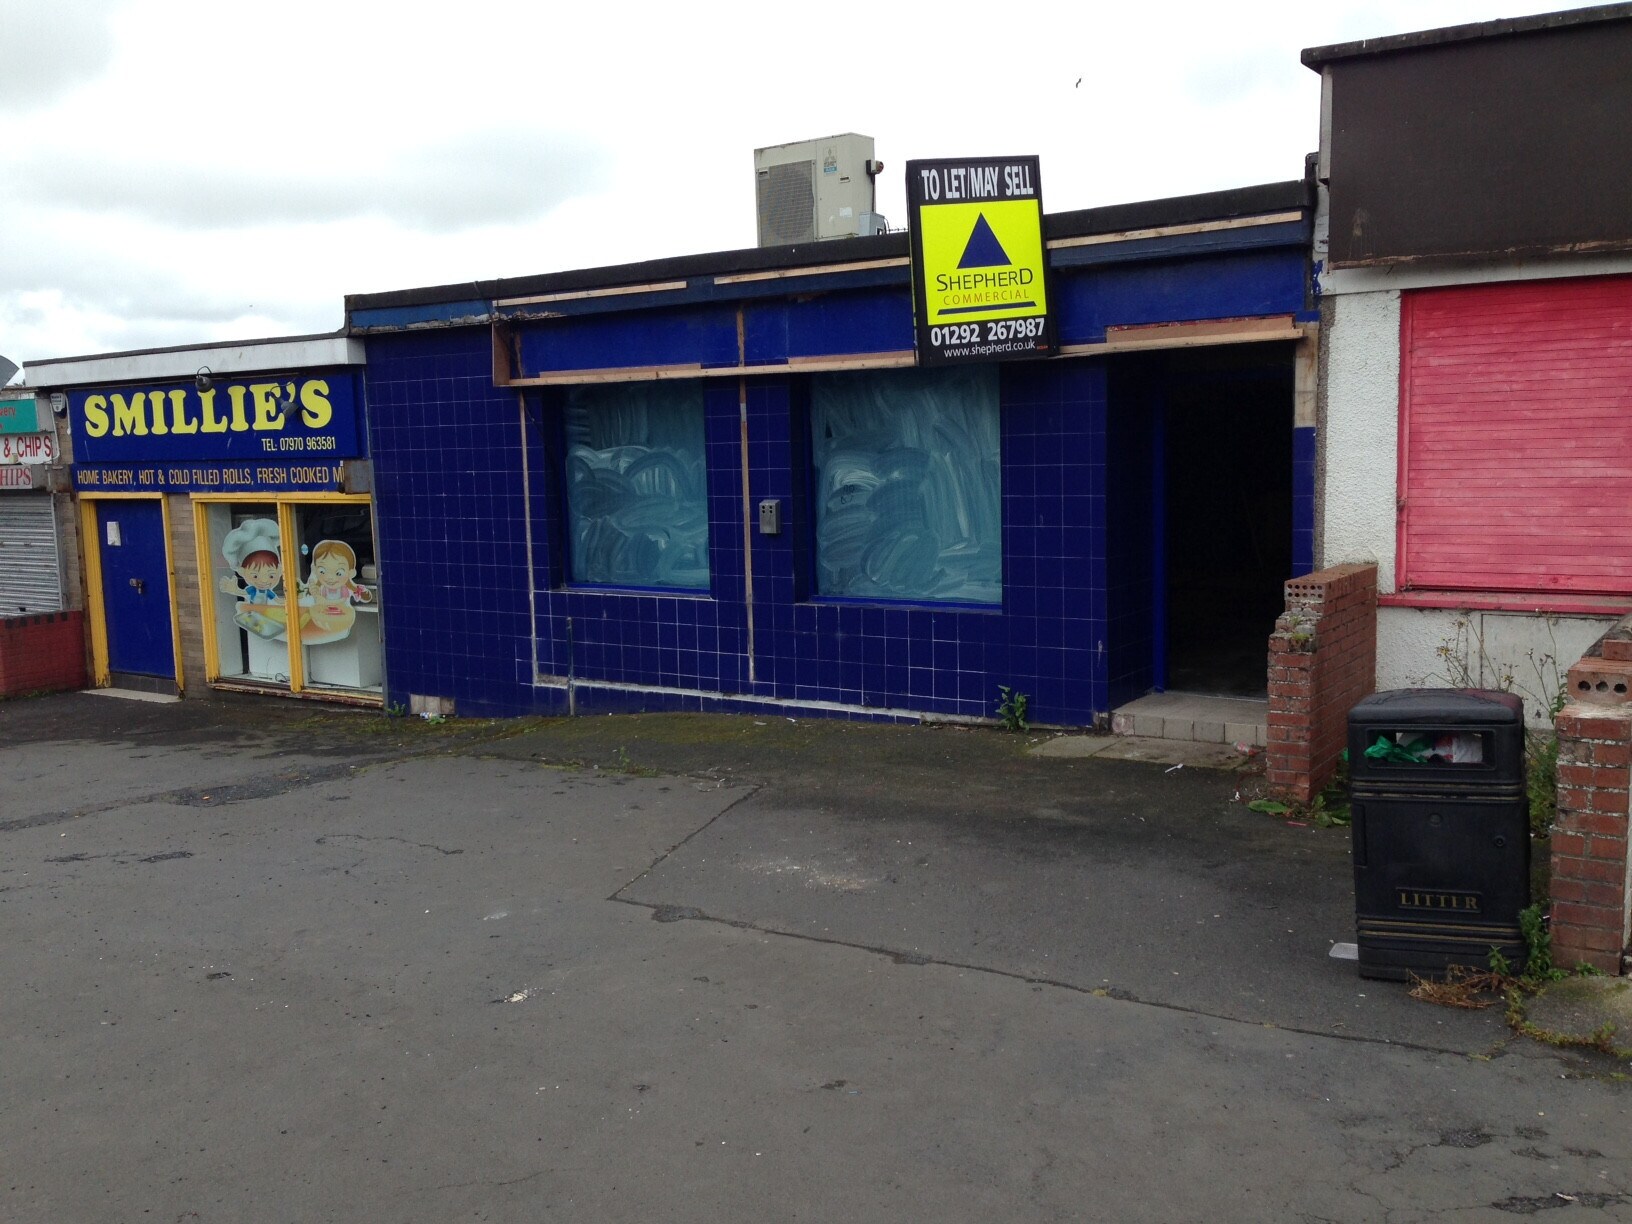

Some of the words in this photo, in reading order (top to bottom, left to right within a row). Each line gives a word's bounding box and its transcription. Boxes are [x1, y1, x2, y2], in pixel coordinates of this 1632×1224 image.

[921, 169, 939, 200] TO
[1004, 165, 1034, 196] SELL
[937, 268, 1033, 292] SHEPHERD
[943, 289, 1029, 305] COMMERCIAL
[931, 326, 980, 346] 01292
[987, 318, 1045, 341] 267987
[944, 339, 1035, 358] www.shepherd.co.uk
[85, 379, 332, 437] SMILLIE'S
[3, 436, 11, 458] &
[16, 435, 52, 457] CHIPS
[261, 438, 277, 451] TEL:
[279, 437, 304, 451] 07970
[306, 436, 336, 450] 963581
[78, 470, 100, 484] HOME
[102, 470, 136, 486] BAKERY,
[138, 470, 155, 484] HOT
[157, 469, 165, 484] &
[168, 470, 190, 485] COLD
[192, 469, 220, 485] FILLED
[223, 468, 254, 485] ROLLS,
[257, 467, 287, 484] FRESH
[290, 466, 329, 483] COOKED
[333, 466, 345, 483] M
